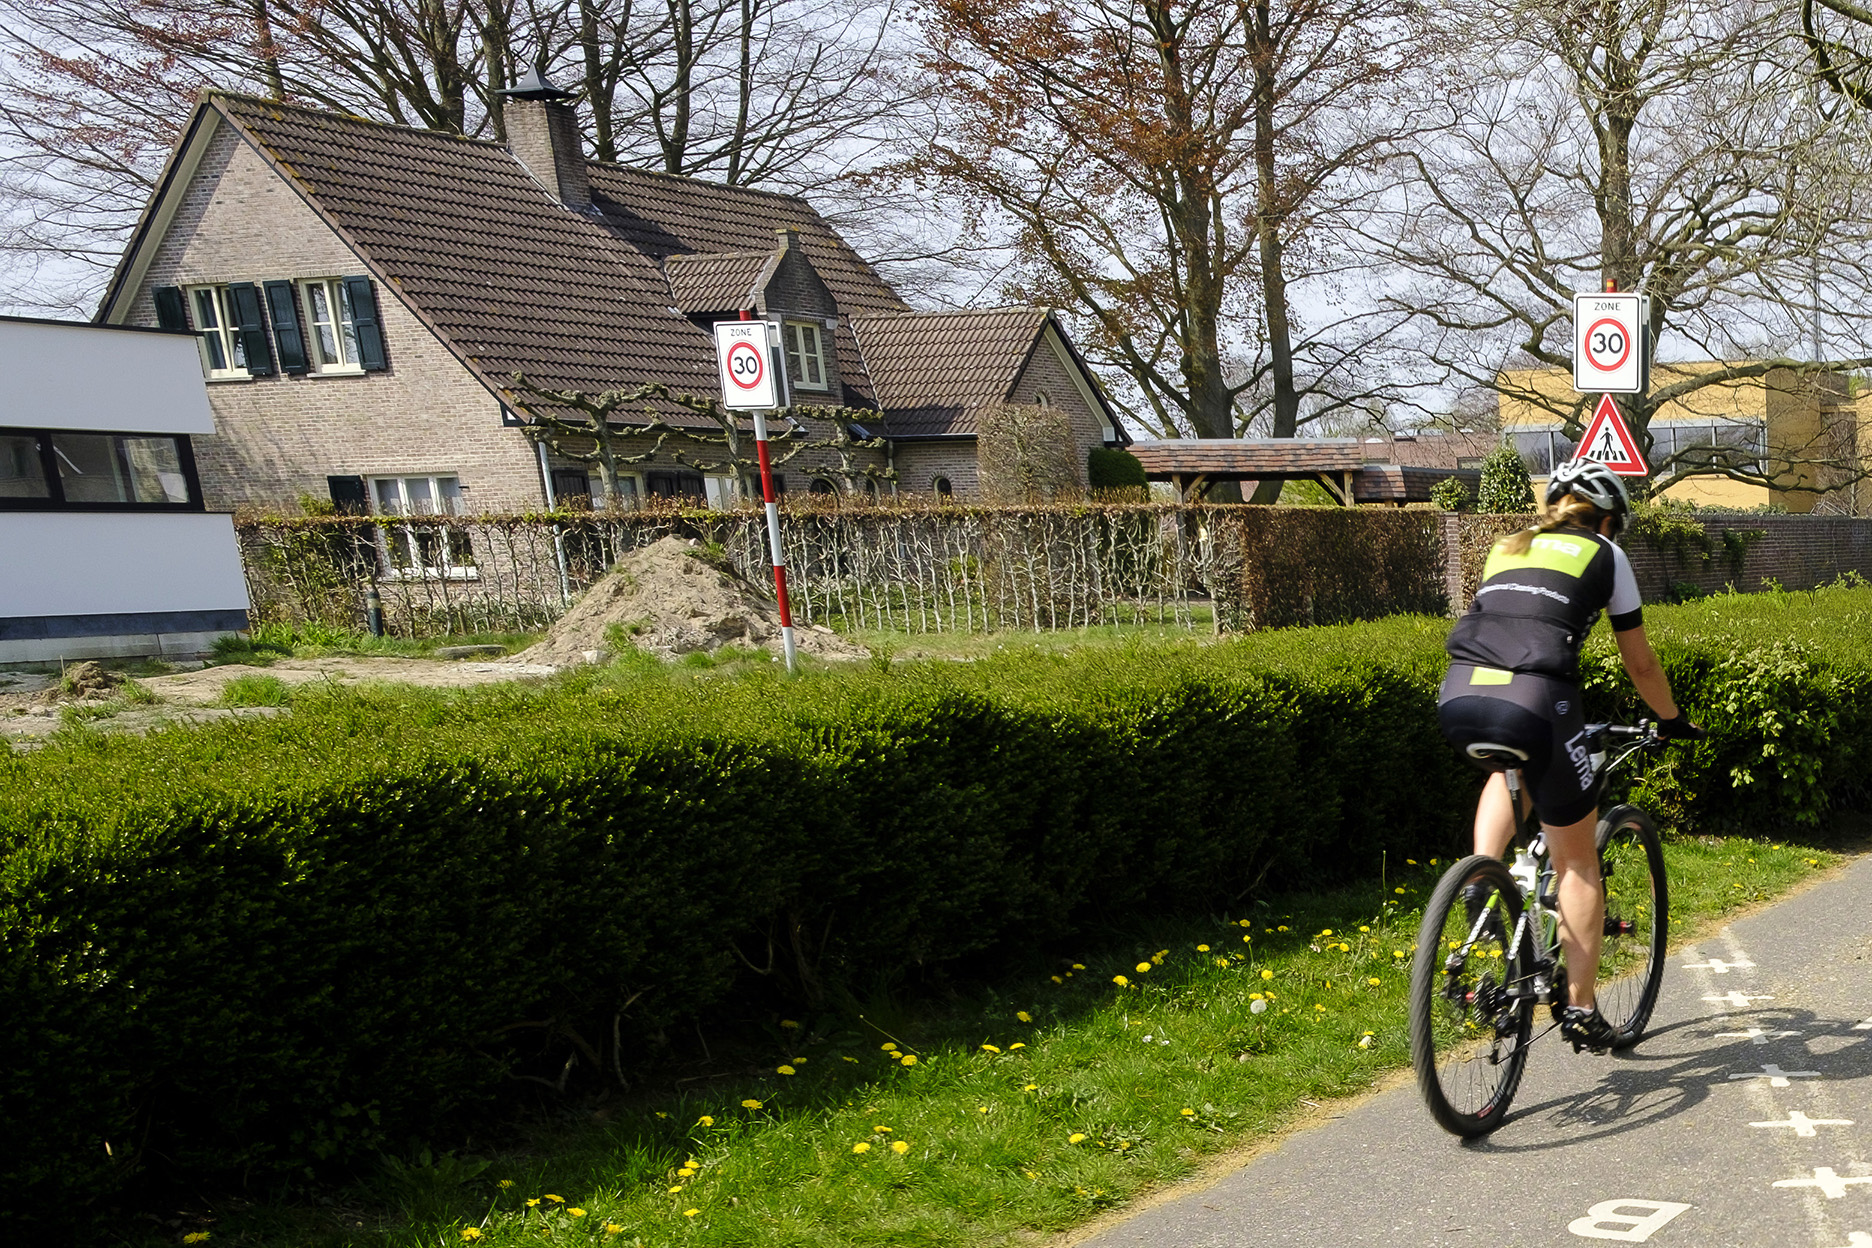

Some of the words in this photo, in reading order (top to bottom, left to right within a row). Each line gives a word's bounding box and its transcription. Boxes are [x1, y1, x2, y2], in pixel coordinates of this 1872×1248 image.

[1594, 302, 1621, 311] ZONE
[730, 328, 751, 336] ZONE
[1593, 332, 1623, 354] 30
[734, 356, 757, 375] 30
[1564, 730, 1594, 791] Lema
[1568, 1199, 1692, 1242] B
